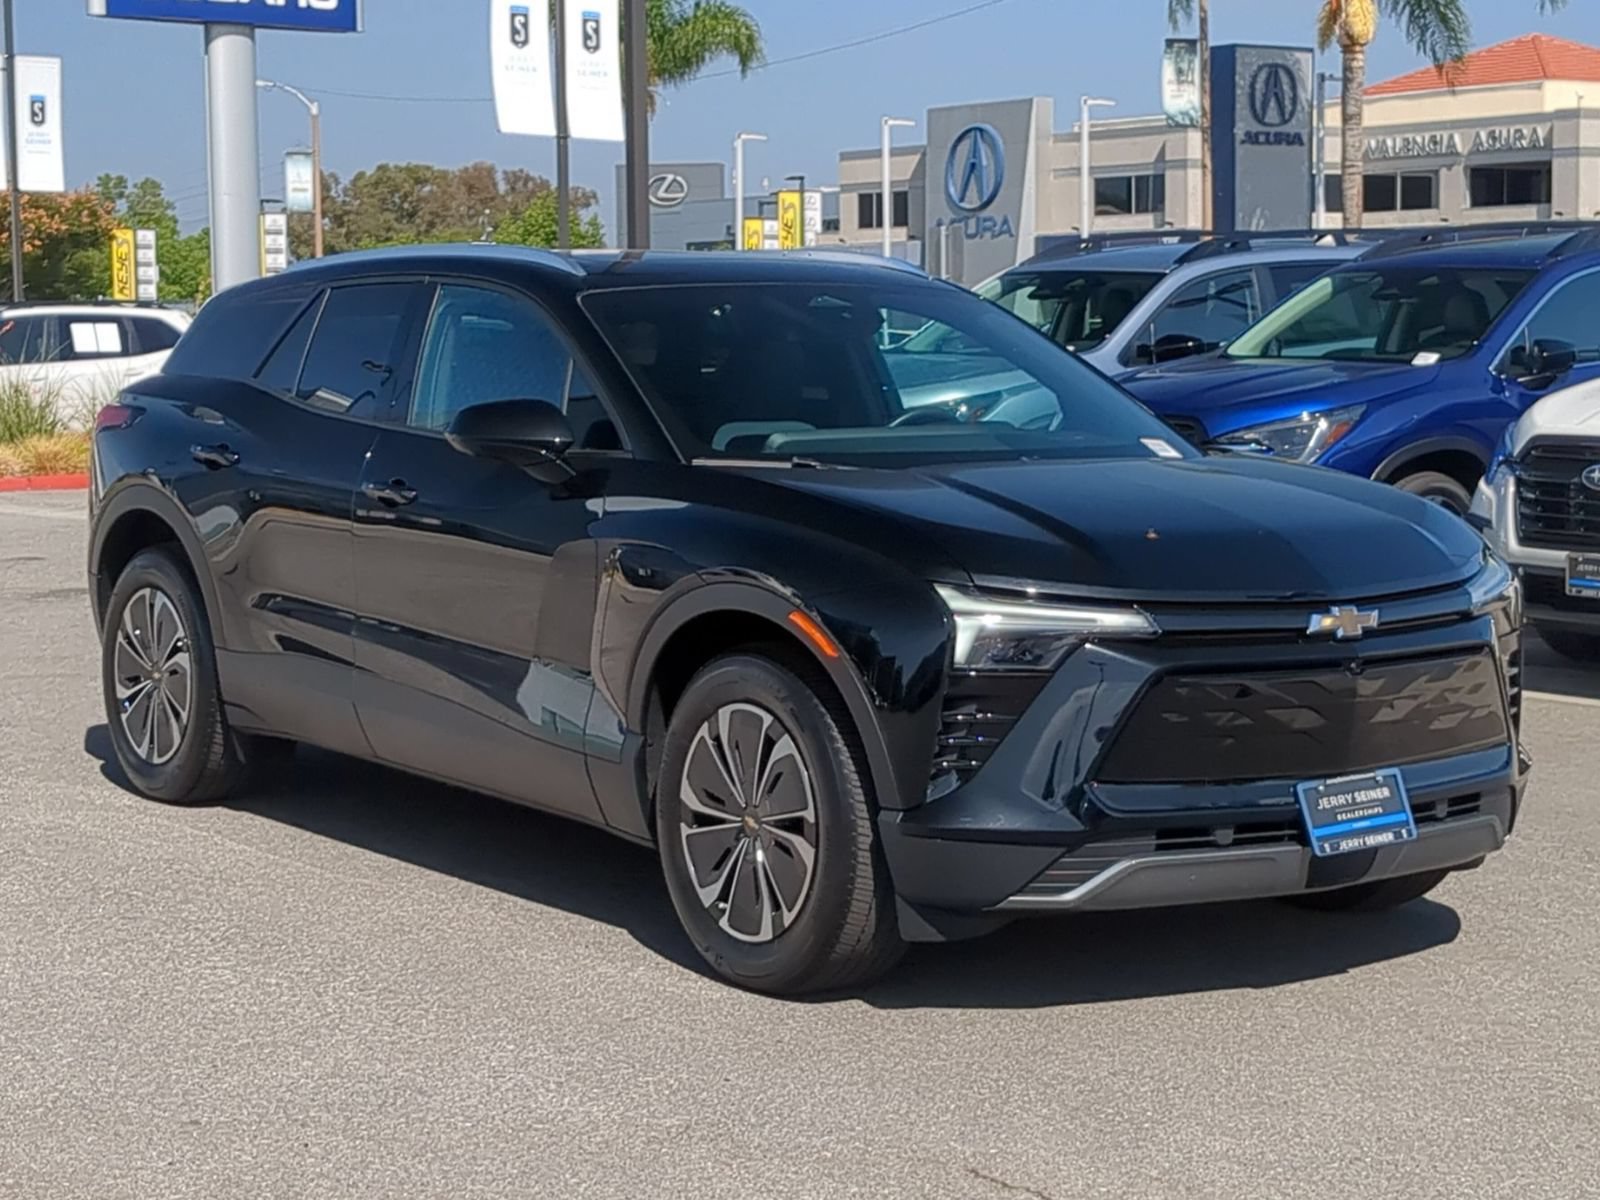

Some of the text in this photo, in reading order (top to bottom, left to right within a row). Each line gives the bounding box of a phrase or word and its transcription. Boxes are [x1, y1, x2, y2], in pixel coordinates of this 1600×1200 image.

[1240, 130, 1305, 146] ACURA
[1366, 127, 1545, 159] VALENCIA ACURA
[937, 214, 1015, 240] URA
[1317, 786, 1391, 810] JERRY SEINER
[1336, 806, 1384, 821] DEALERSHIPS
[1338, 837, 1366, 851] JERRY
[1365, 832, 1395, 846] SEINER
